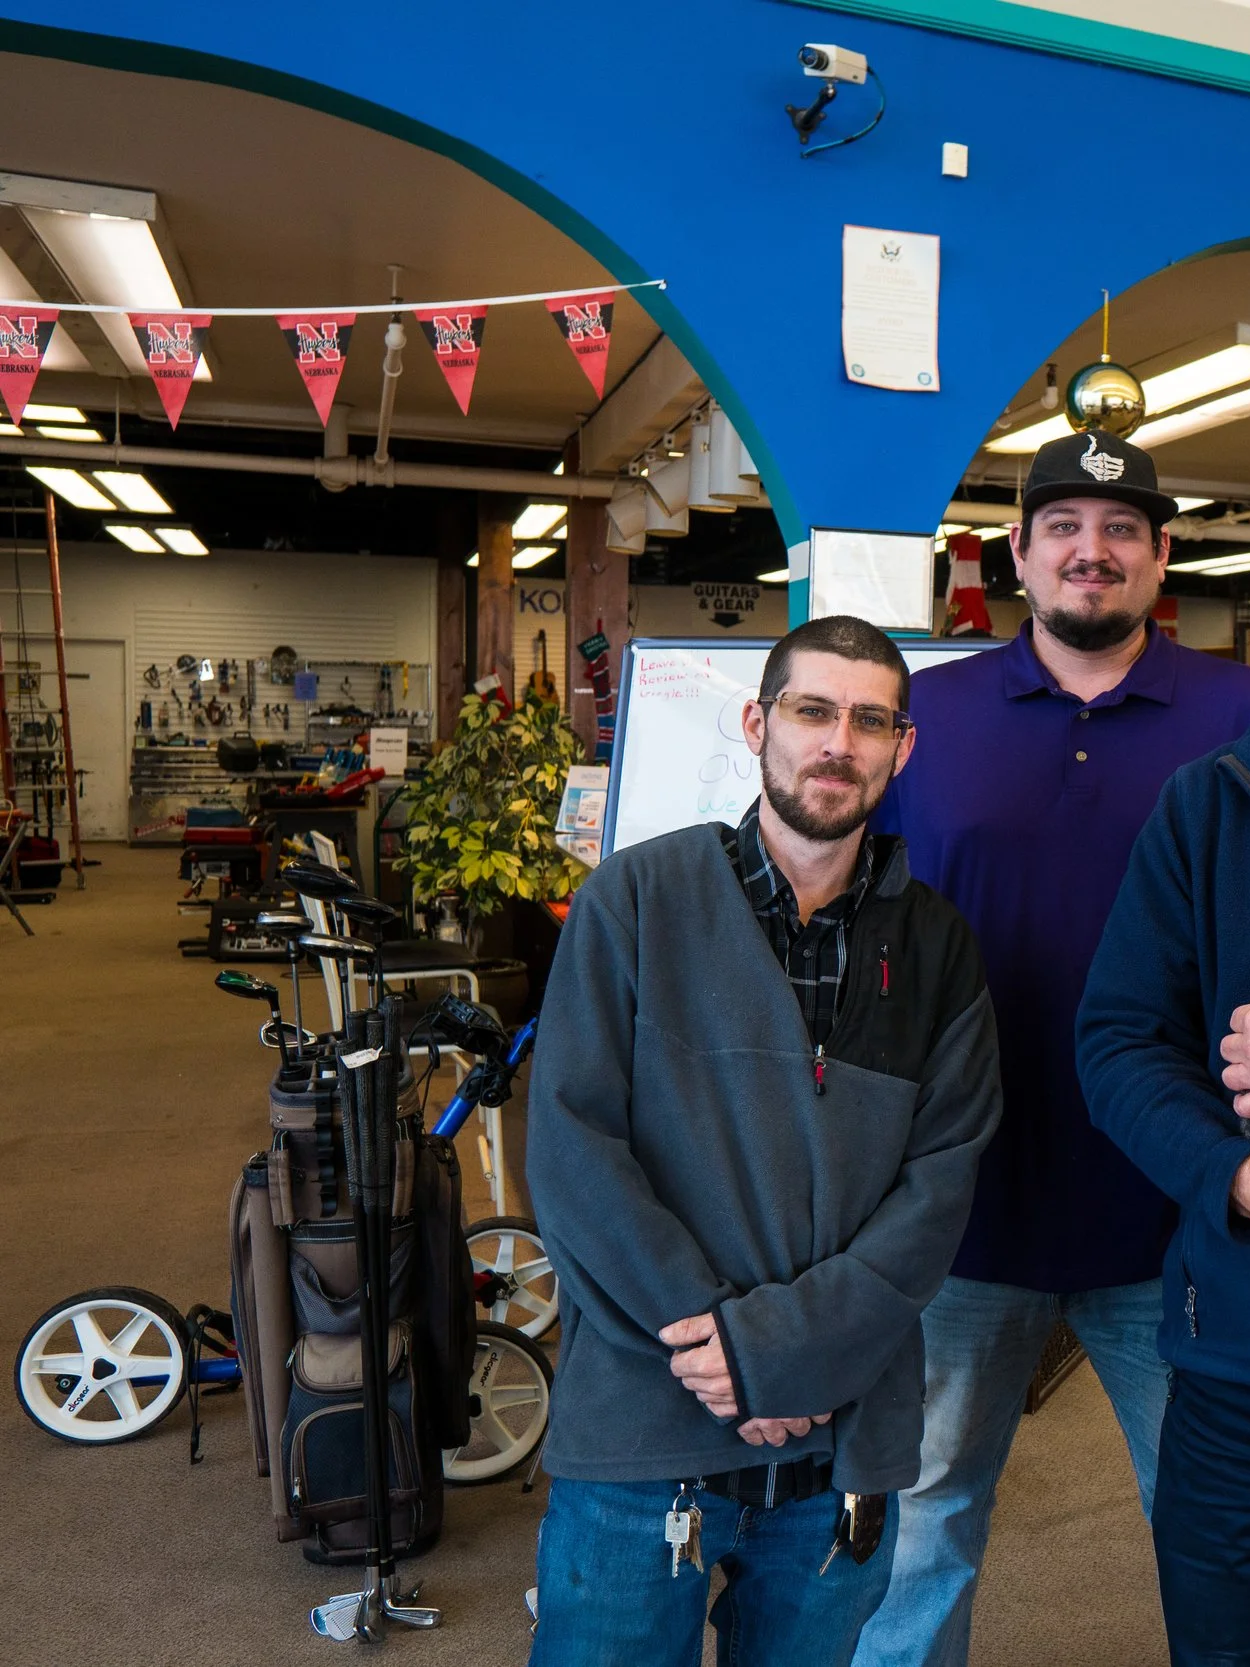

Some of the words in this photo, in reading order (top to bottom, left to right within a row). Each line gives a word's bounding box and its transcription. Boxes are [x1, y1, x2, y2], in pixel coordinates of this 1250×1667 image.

[564, 301, 606, 342] N
[147, 322, 194, 364] N
[149, 332, 194, 354] Huskers
[296, 322, 341, 364] N
[433, 314, 475, 355] N
[304, 367, 338, 377] NEBRASKA
[442, 359, 474, 369] NEBRASKA
[154, 369, 190, 379] NEBRASKA
[693, 584, 760, 599] GUITARS
[520, 588, 566, 614] KO
[699, 598, 708, 610] &
[713, 599, 754, 611] GEAR
[640, 657, 676, 671] Leave
